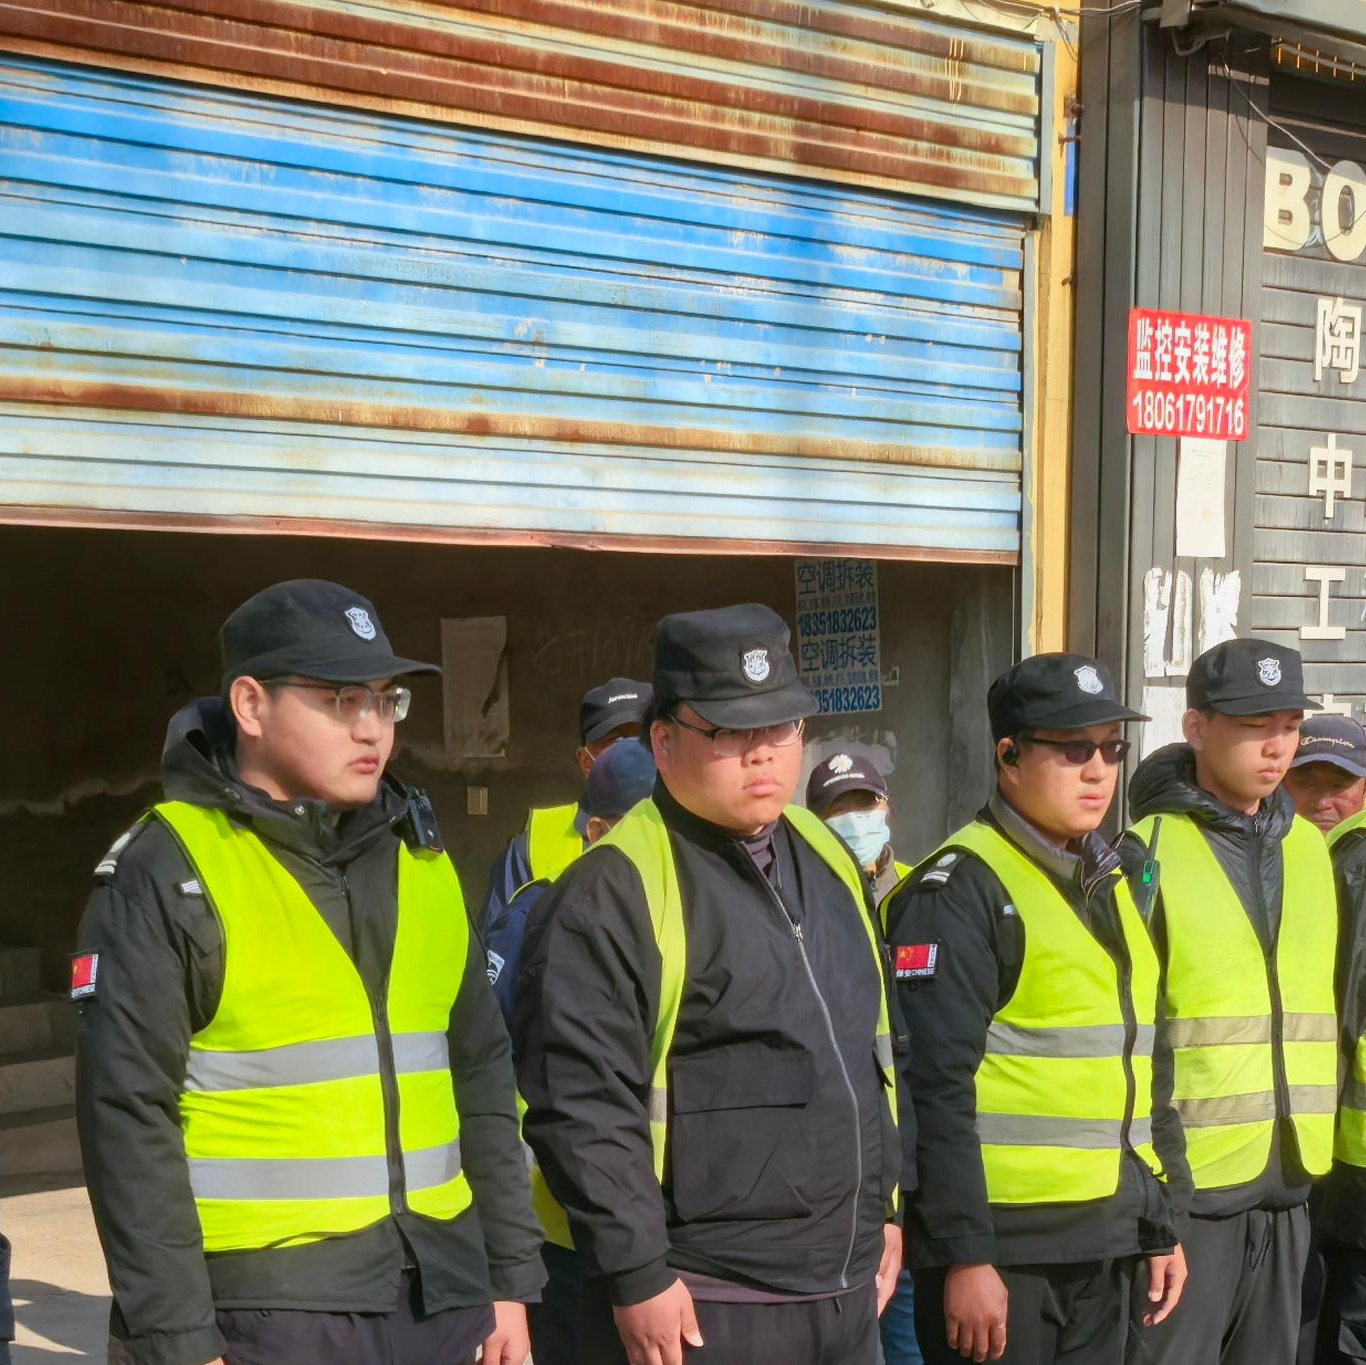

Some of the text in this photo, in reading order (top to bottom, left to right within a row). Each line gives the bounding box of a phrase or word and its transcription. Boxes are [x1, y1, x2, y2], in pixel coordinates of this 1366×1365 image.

[1133, 317, 1246, 390] 监控安装维修
[1132, 389, 1245, 436] 18061791716
[797, 561, 875, 595] 空调拆装
[798, 606, 877, 638] 18351832623
[801, 634, 877, 672] 空调拆装
[811, 685, 881, 714] 351832623
